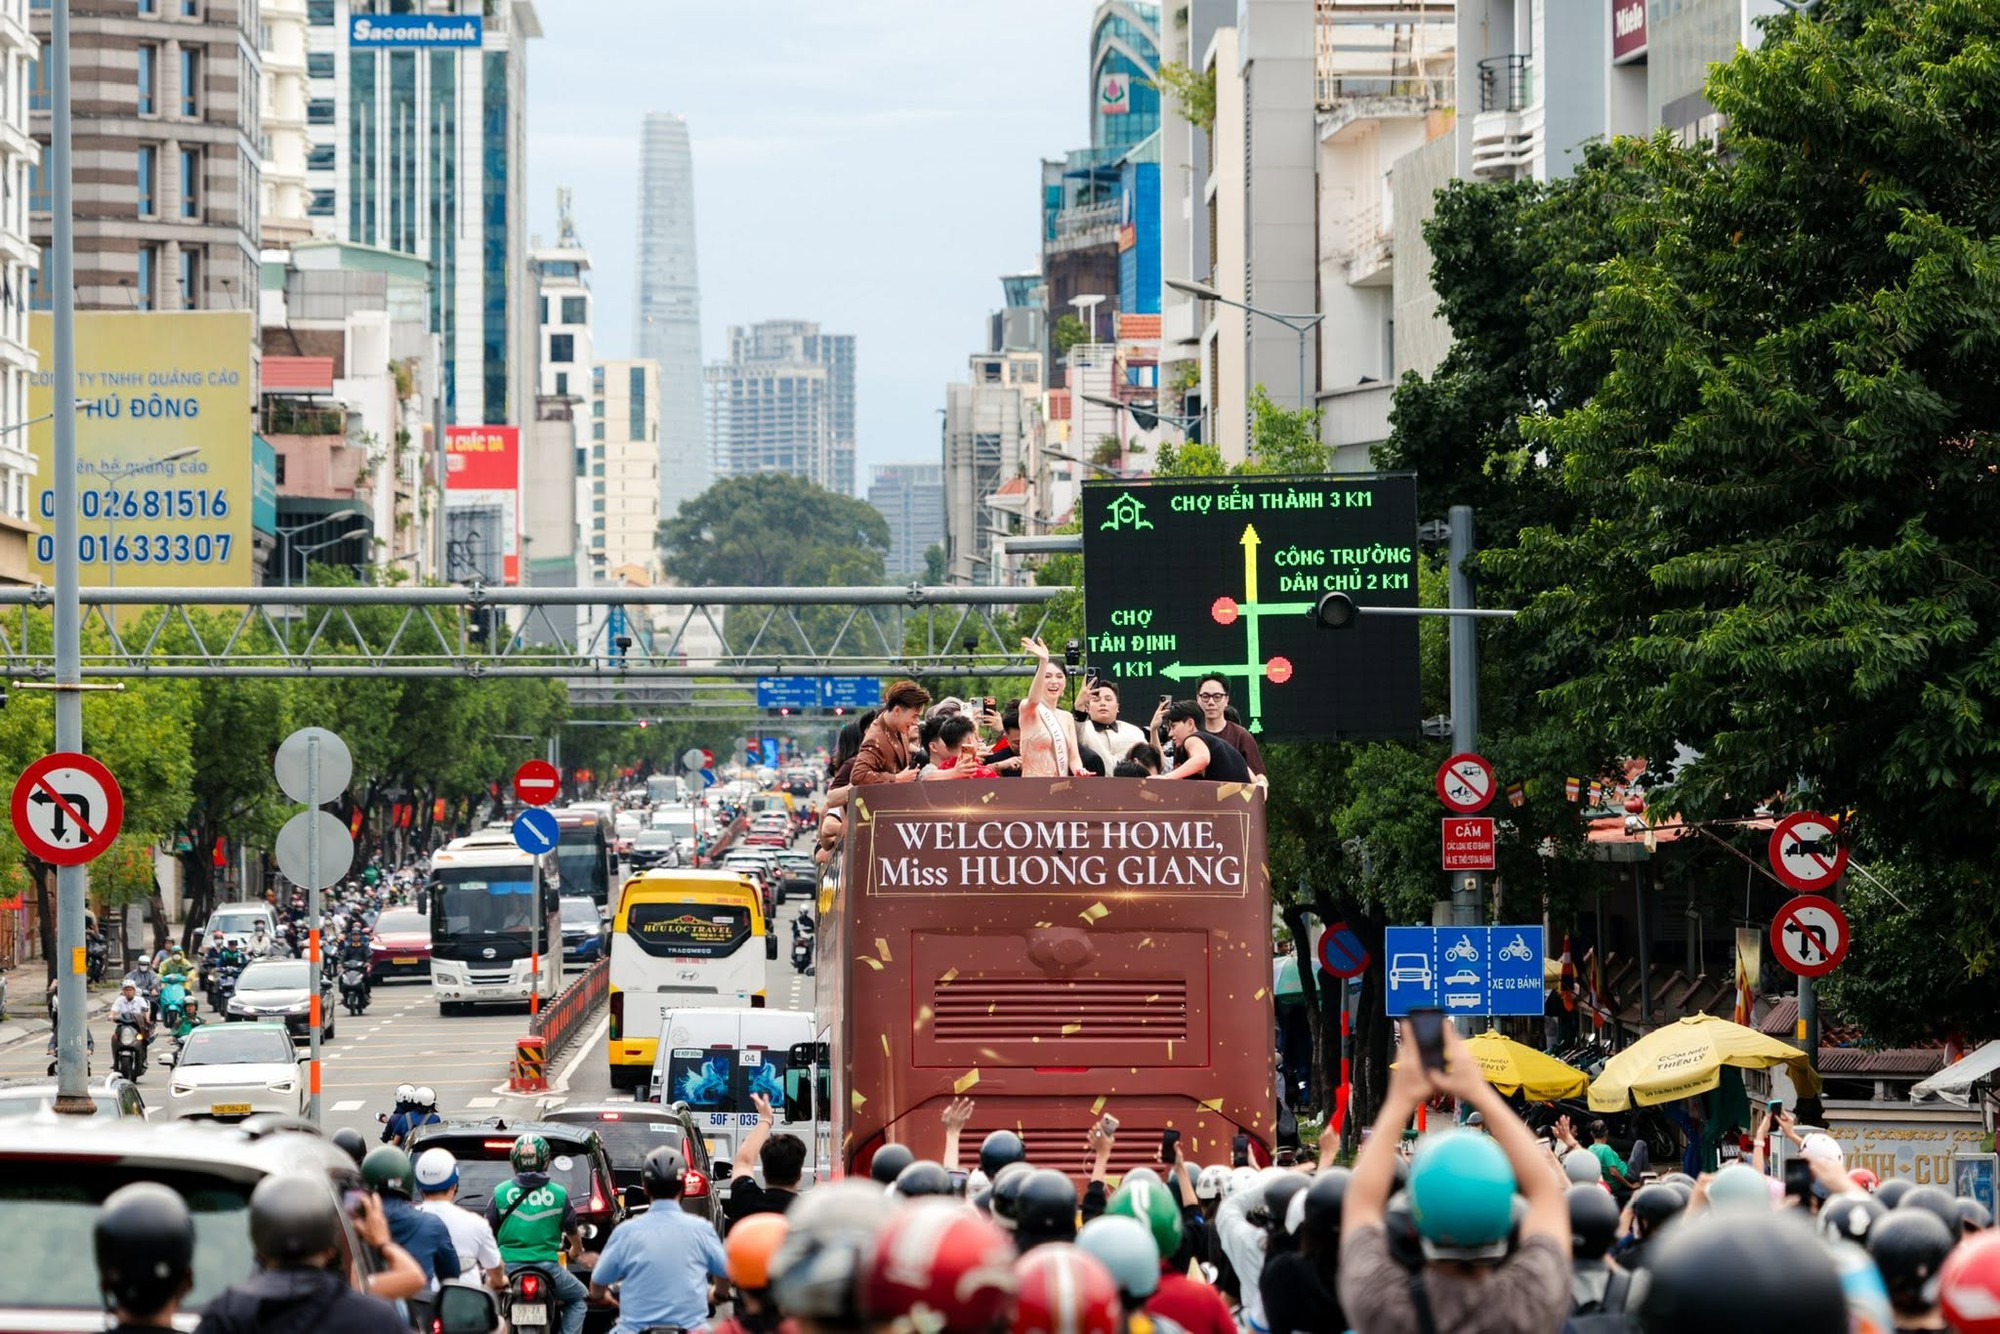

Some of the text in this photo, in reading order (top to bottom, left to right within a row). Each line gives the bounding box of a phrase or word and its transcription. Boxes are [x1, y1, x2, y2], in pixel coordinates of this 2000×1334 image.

[353, 19, 476, 40] Sacombank
[1616, 2, 1643, 38] Miele
[78, 372, 97, 386] TY
[102, 372, 143, 386] TNHH
[40, 489, 228, 518] 002681516
[1171, 484, 1372, 514] CHỢ BẾN THÀNH 3 KM
[37, 534, 232, 563] 001633307
[1274, 543, 1411, 566] CÔNG TRƯỜNG
[1280, 568, 1409, 592] DÂN CHỦ 2 KM
[1111, 609, 1152, 628] CHỢ
[1087, 631, 1176, 654] TÂN ĐỊNH
[1113, 661, 1152, 677] 1 KM
[894, 821, 1224, 855] WELCOME HOME,
[1455, 821, 1482, 837] CẤM
[879, 855, 1241, 886] Miss HUONG GIANG
[691, 925, 732, 934] TRAVEL
[1492, 974, 1541, 989] XE 02 BÁNH
[744, 1054, 755, 1063] 04
[710, 1113, 728, 1126] 50F
